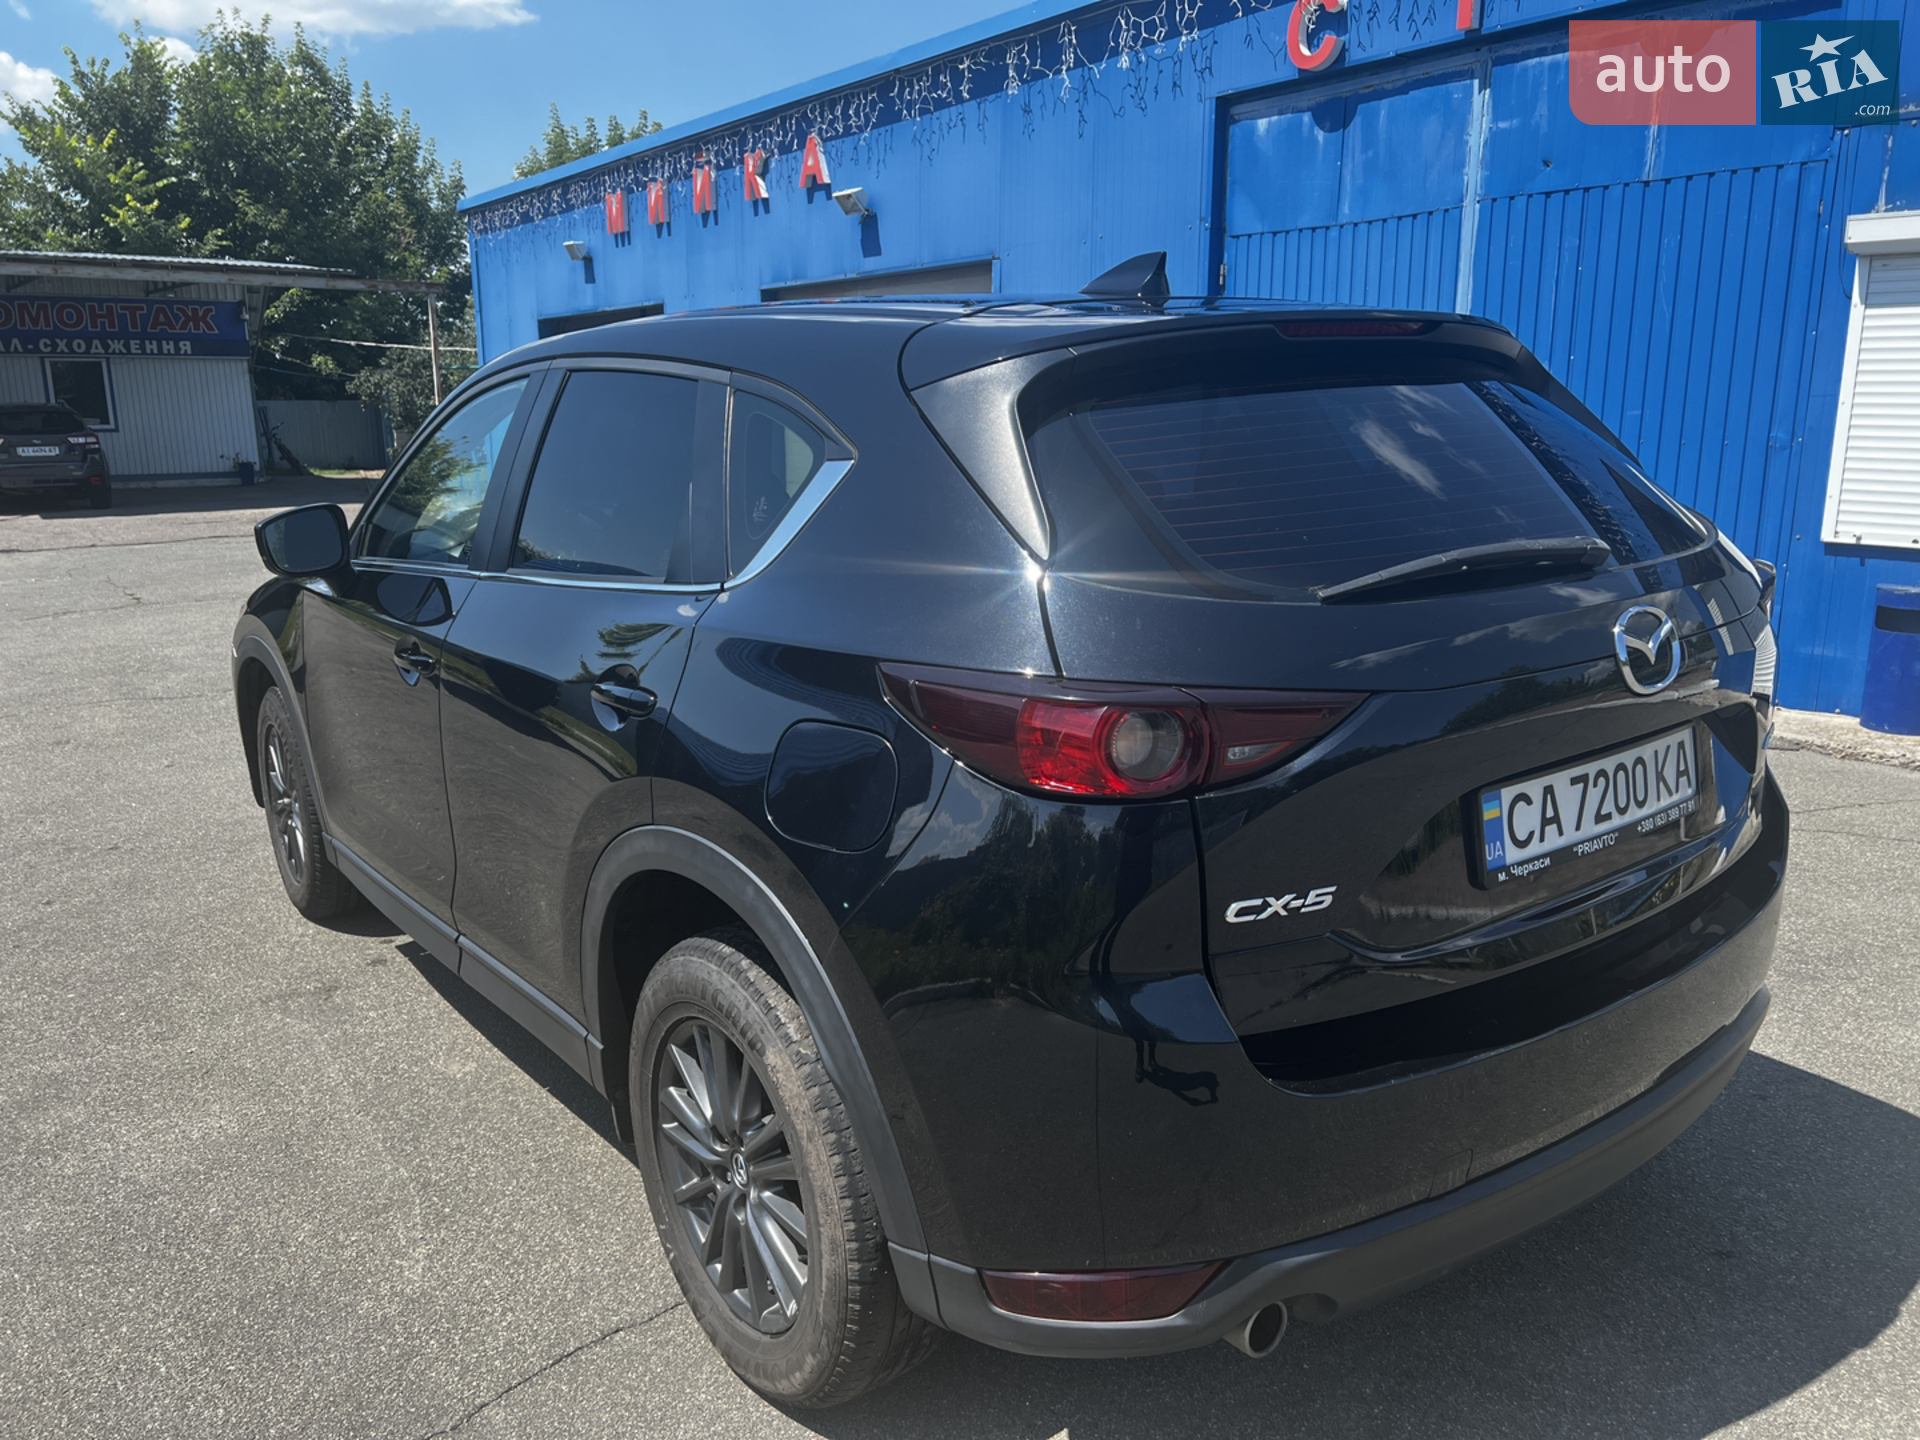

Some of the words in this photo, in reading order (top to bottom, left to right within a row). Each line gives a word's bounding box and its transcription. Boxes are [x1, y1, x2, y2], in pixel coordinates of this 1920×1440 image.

[1507, 784, 1565, 849] CA
[1570, 756, 1648, 833] 7200
[1654, 740, 1692, 802] KA
[1485, 840, 1504, 860] UA
[1510, 856, 1551, 877] Черкаси
[1224, 885, 1338, 924] CX-5
